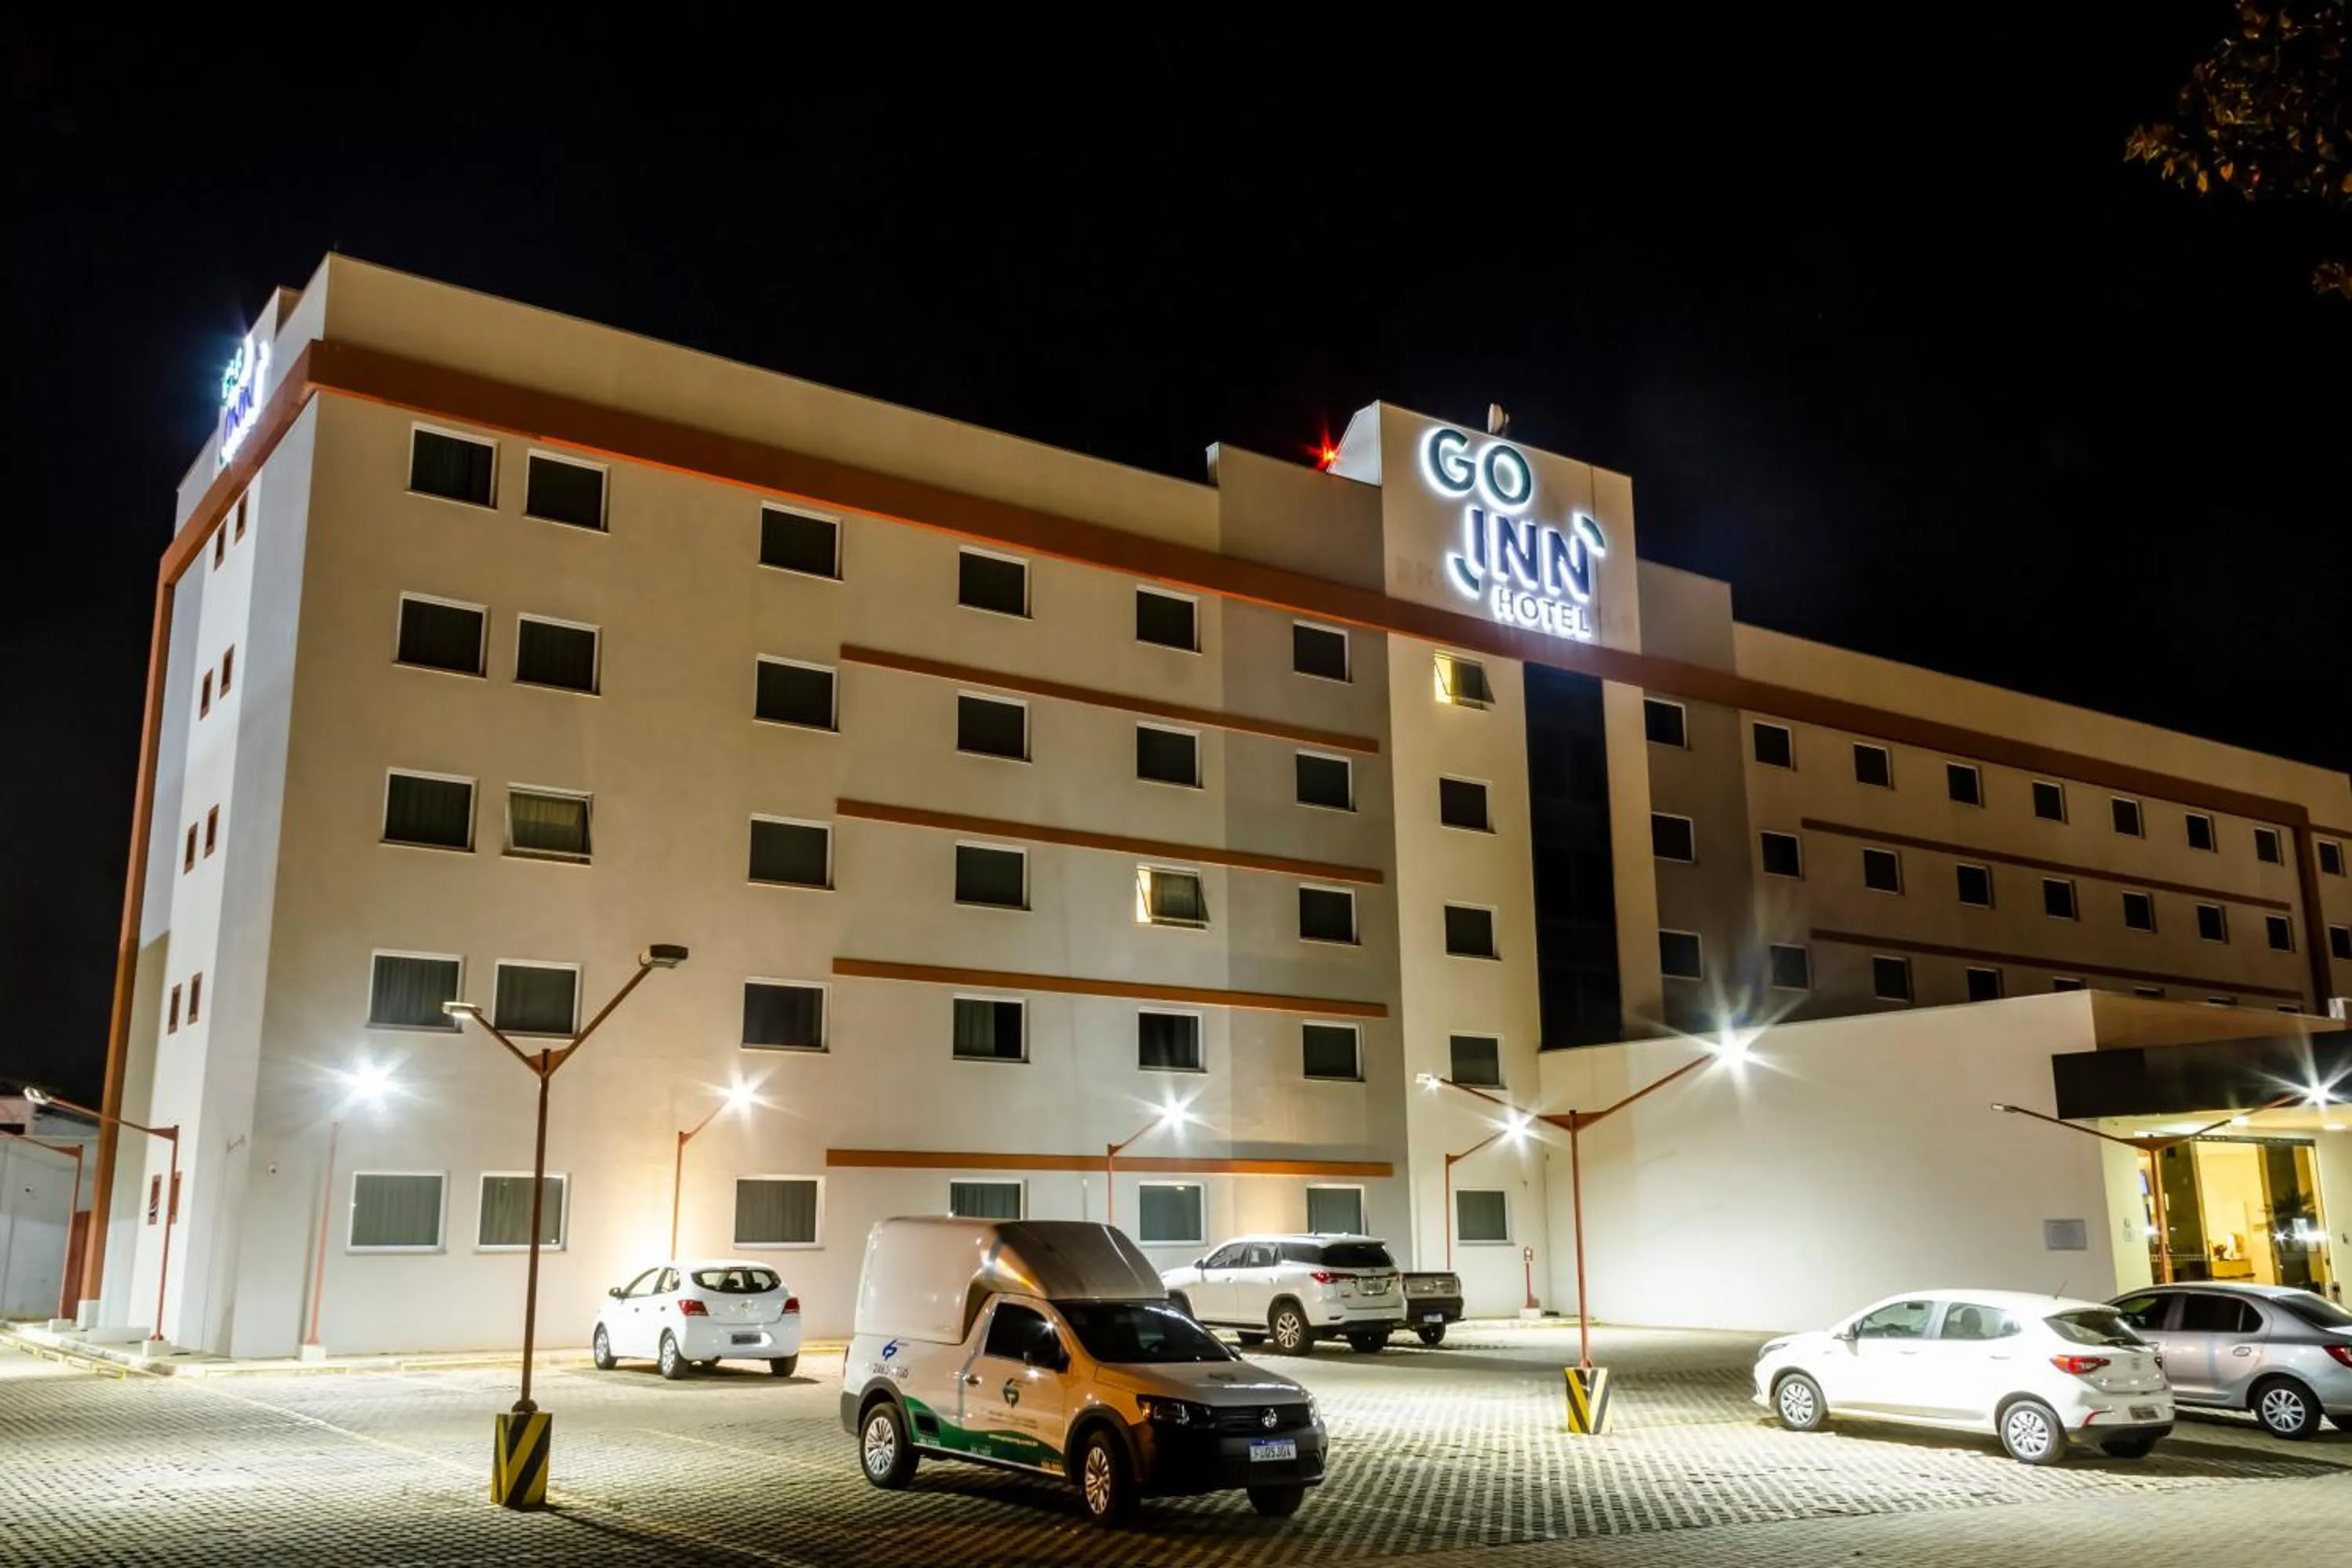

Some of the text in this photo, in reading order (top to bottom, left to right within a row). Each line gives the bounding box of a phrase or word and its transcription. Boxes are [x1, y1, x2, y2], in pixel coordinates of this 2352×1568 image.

[1424, 427, 1533, 509] GO
[1463, 508, 1592, 599] INN
[1495, 588, 1591, 635] HOTEL
